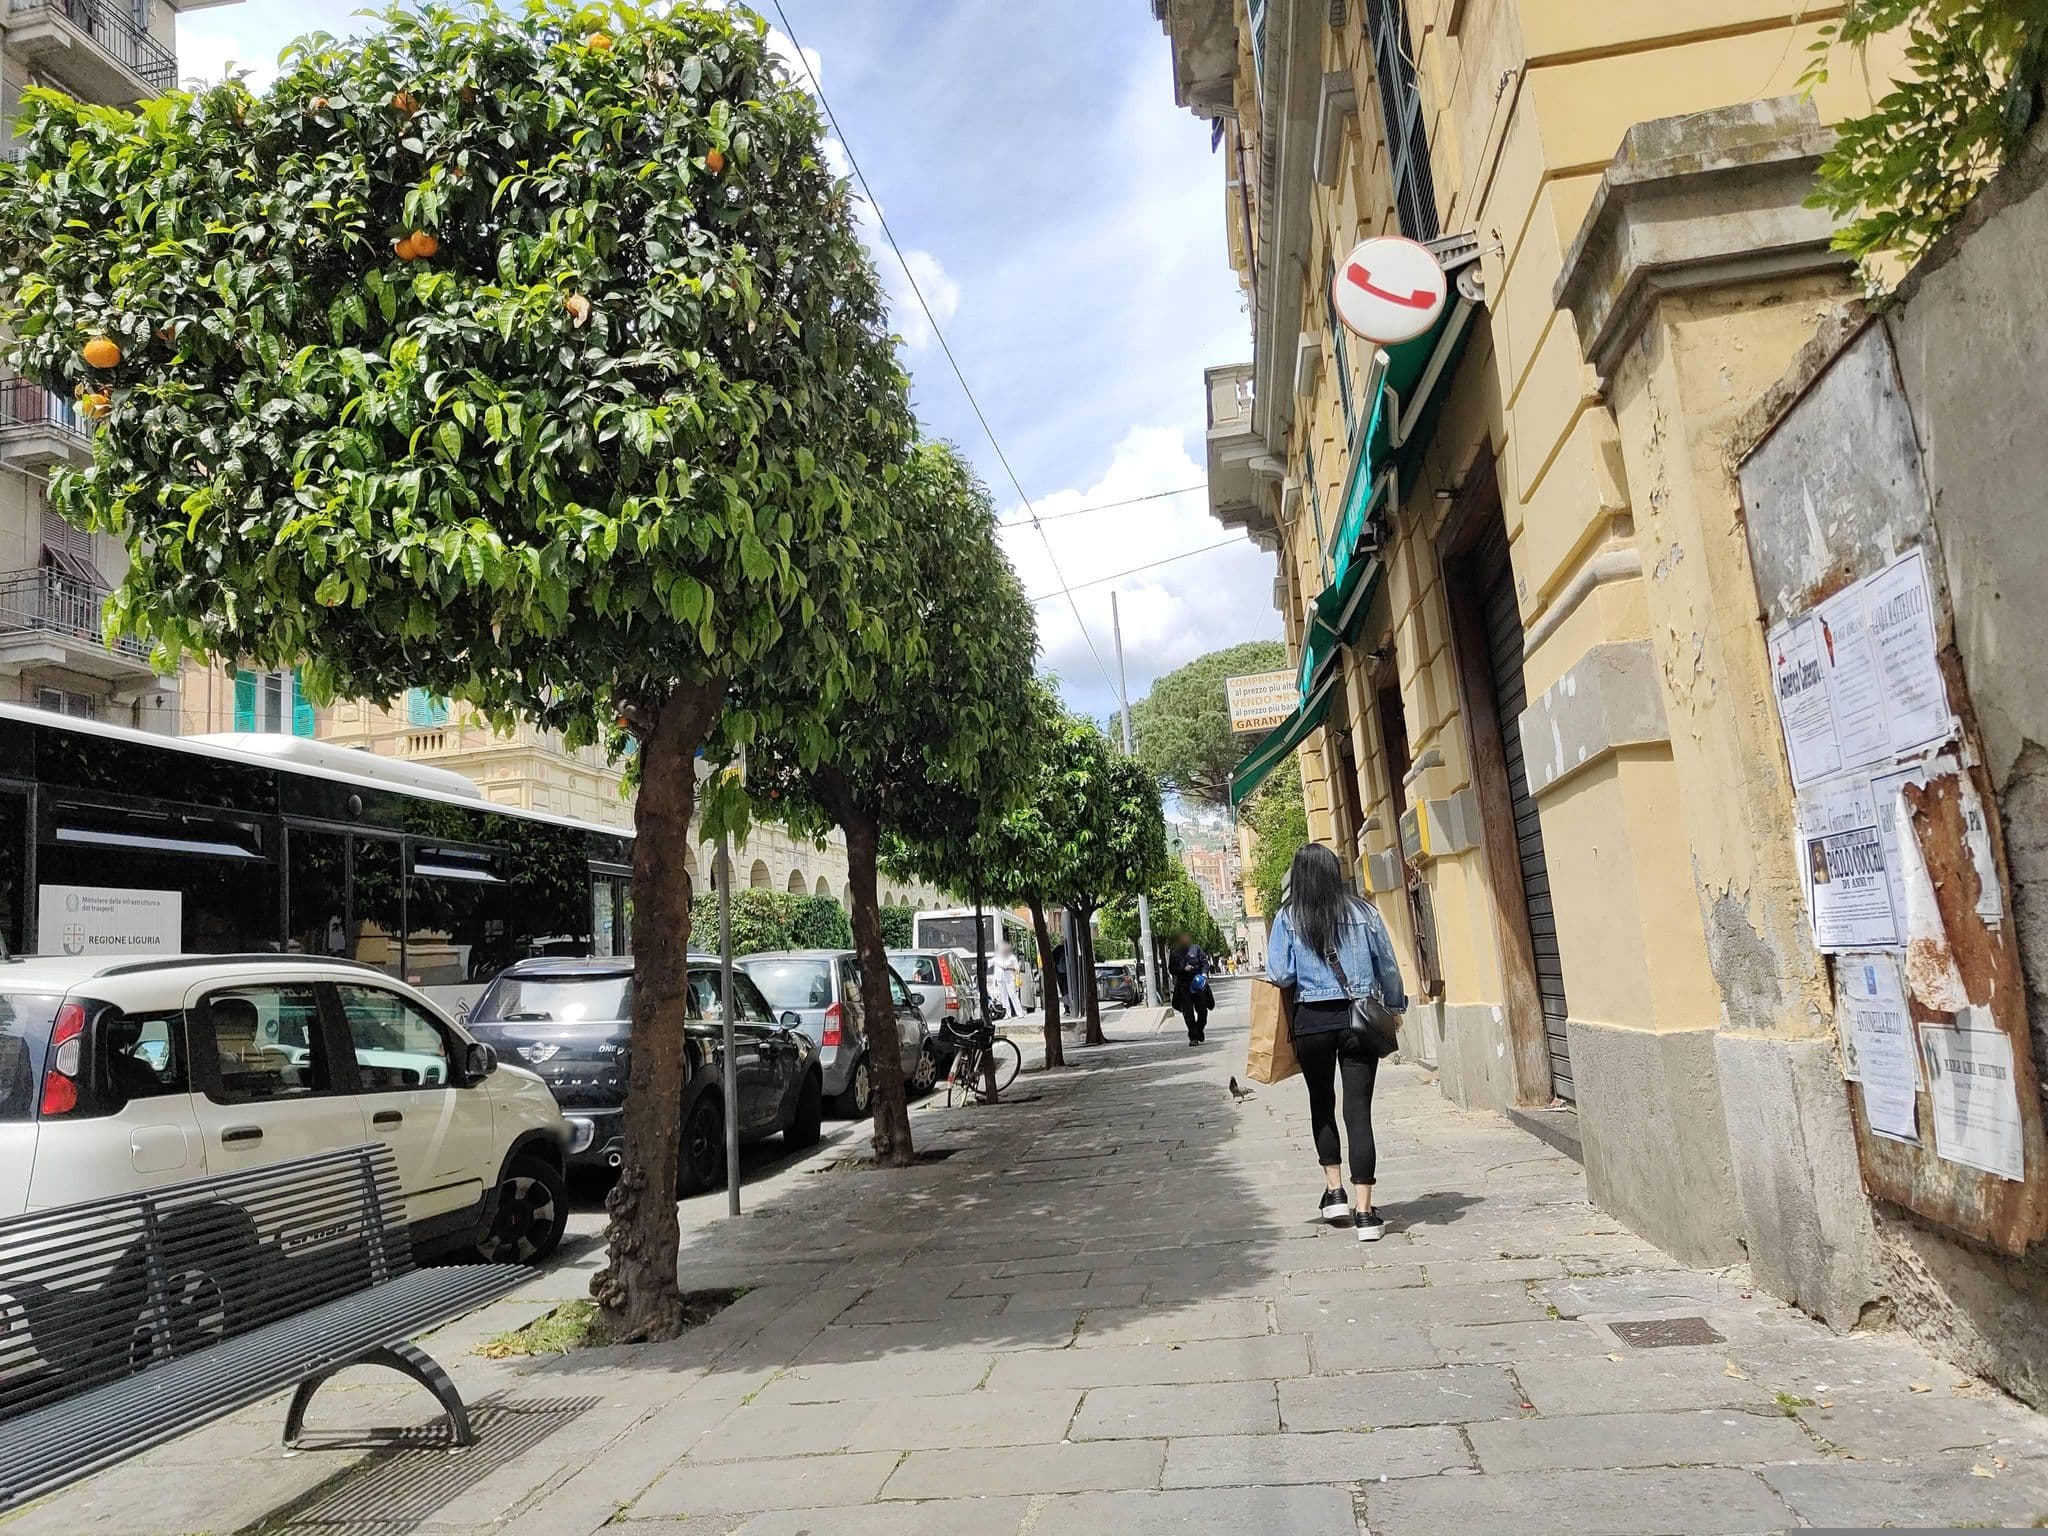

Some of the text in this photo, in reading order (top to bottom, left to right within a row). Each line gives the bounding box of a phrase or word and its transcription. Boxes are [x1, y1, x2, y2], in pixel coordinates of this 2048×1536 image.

[1229, 675, 1272, 687] COMPRO
[1235, 688, 1242, 697] al
[1243, 686, 1267, 697] prezzo
[1232, 695, 1271, 707] VENDO
[1235, 708, 1242, 717] al
[1243, 707, 1267, 718] prezzo
[1281, 702, 1300, 712] bass
[1236, 715, 1287, 729] GARANT
[88, 936, 161, 945] REGIONE LIGURIA
